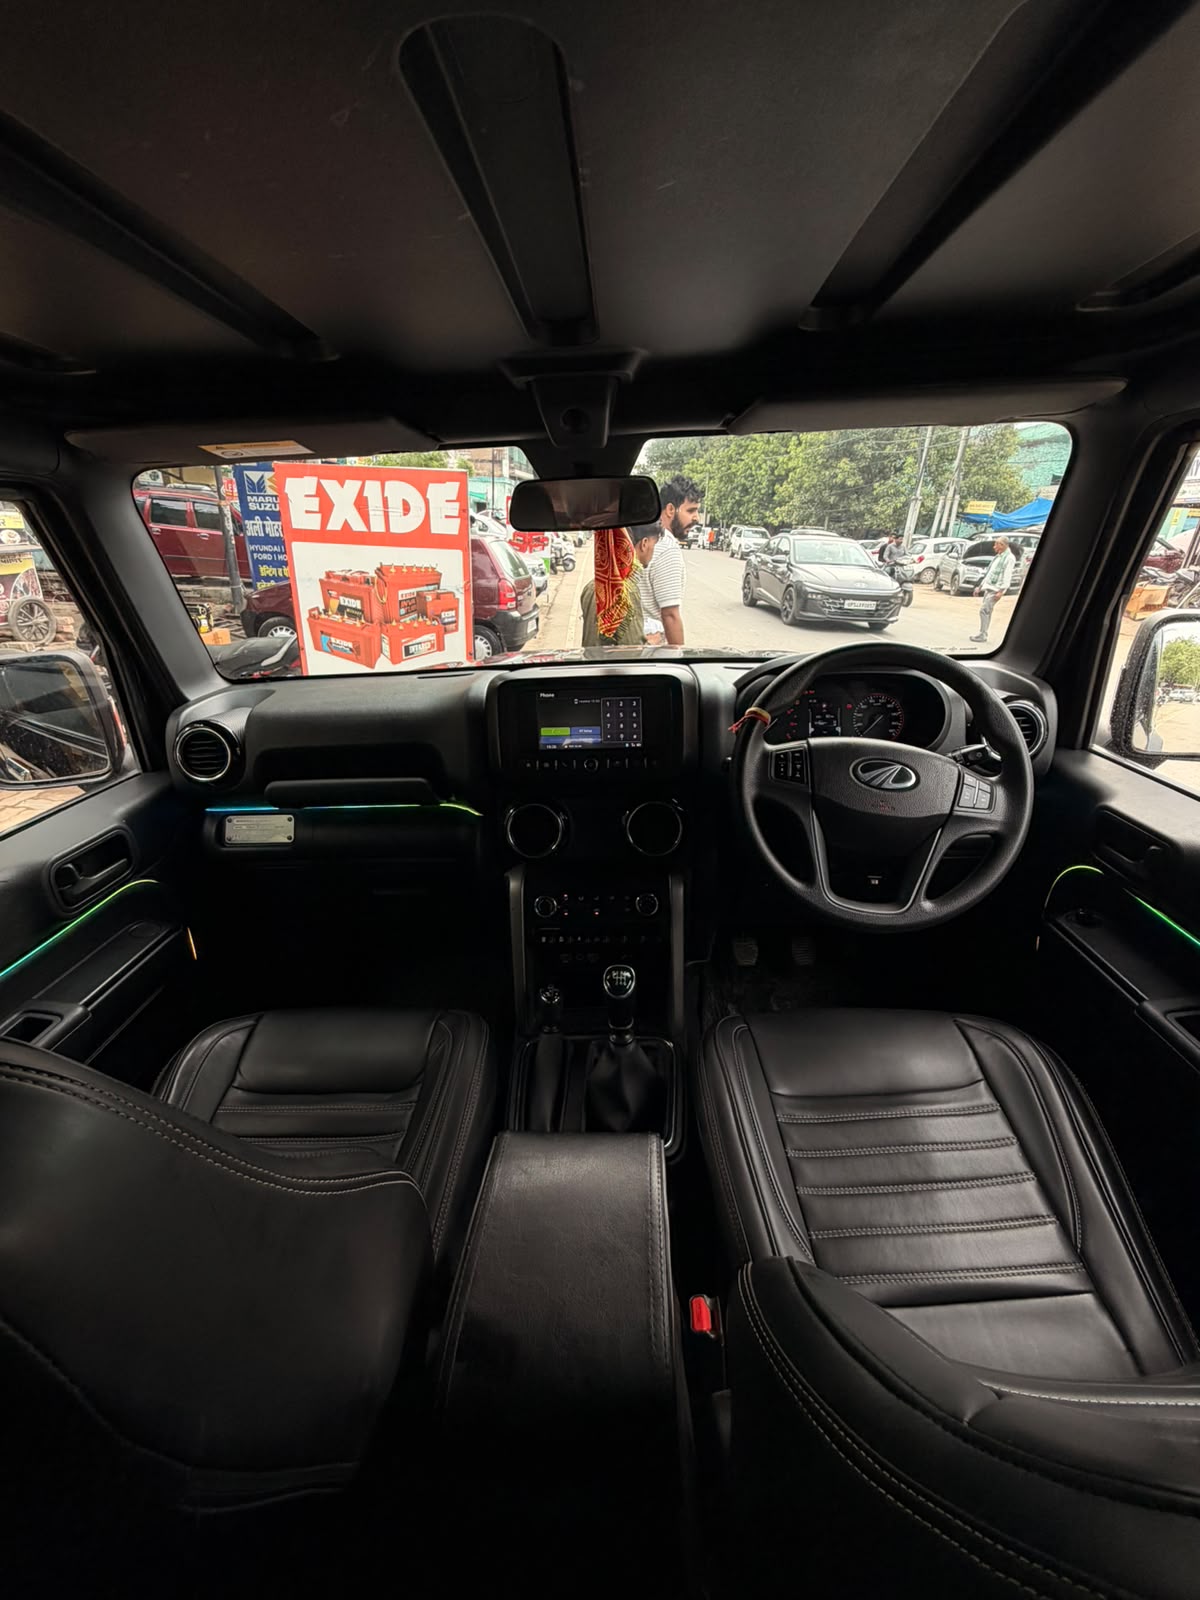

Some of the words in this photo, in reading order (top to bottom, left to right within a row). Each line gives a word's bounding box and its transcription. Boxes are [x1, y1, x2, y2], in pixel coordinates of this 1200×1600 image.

[284, 476, 461, 535] EXIDE
[249, 544, 281, 553] HYUNDAI
[253, 553, 273, 561] FORD
[340, 596, 361, 609] EXIDE
